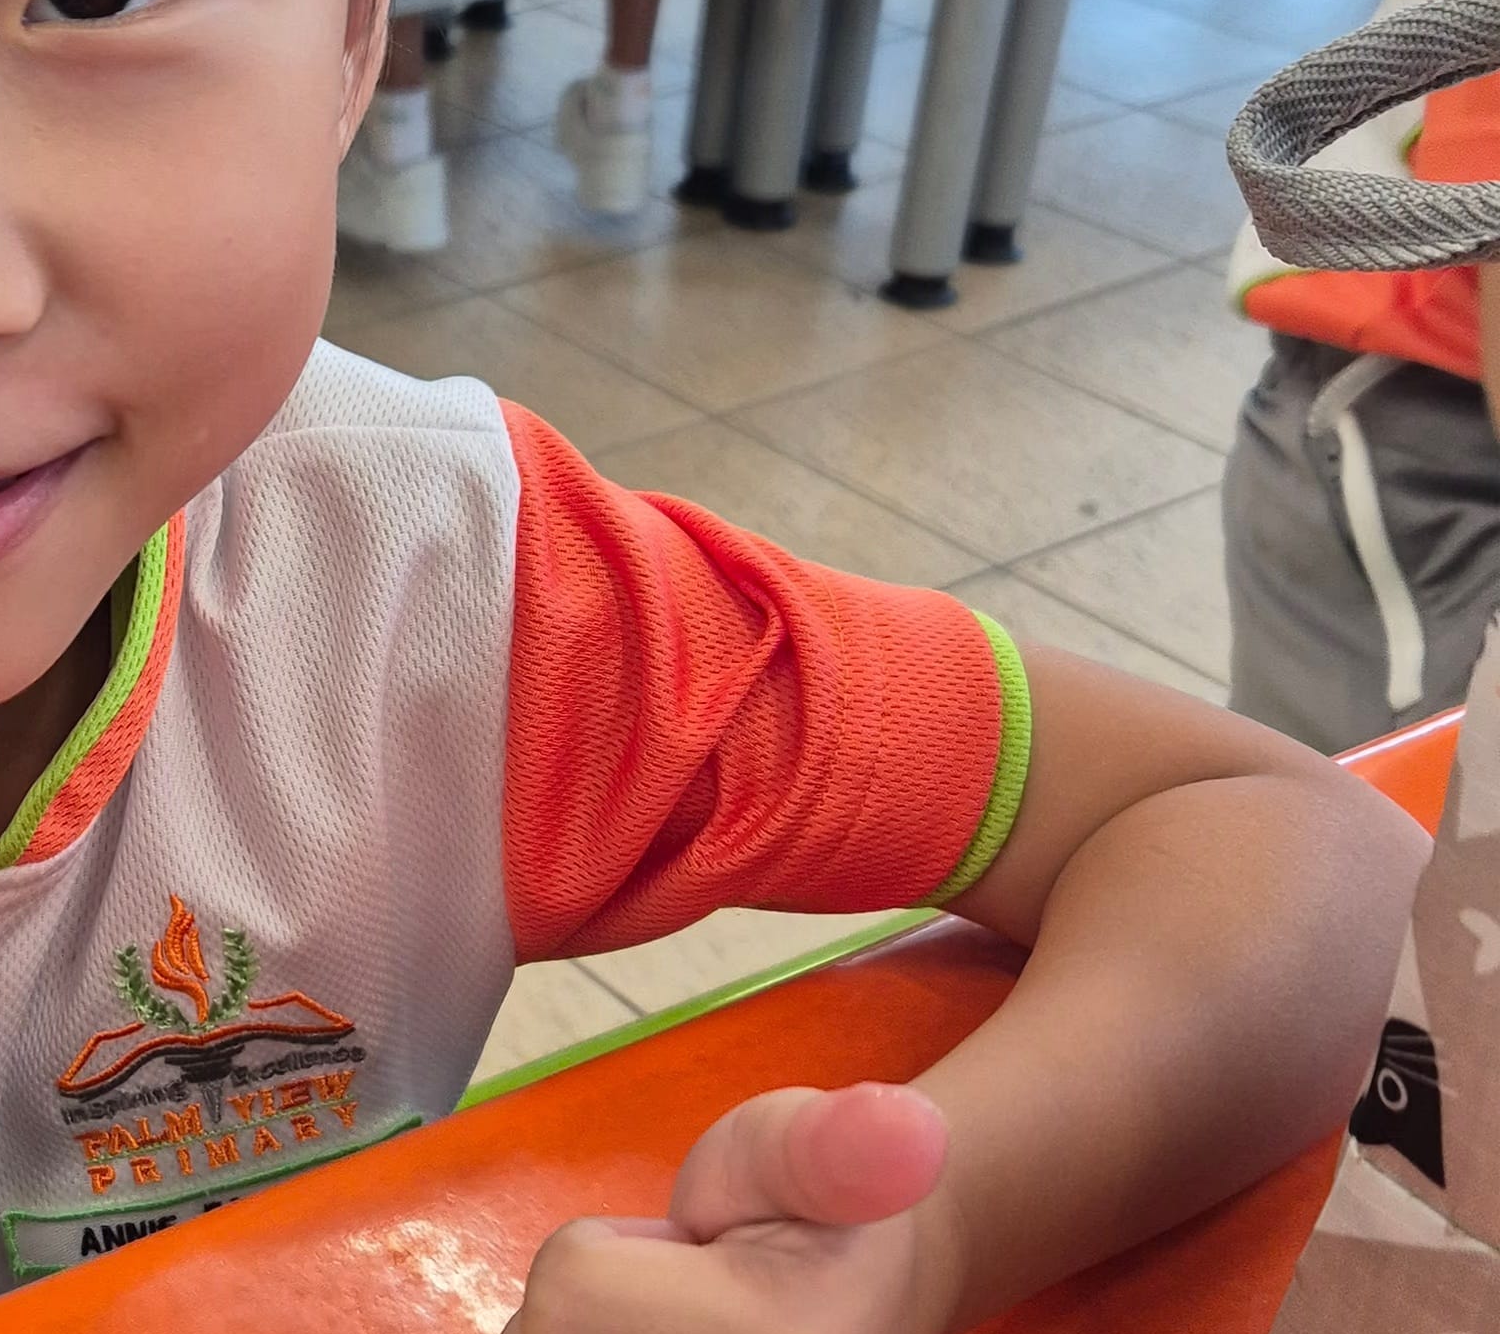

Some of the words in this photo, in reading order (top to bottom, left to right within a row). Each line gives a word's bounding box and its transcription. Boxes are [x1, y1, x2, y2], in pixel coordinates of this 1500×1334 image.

[75, 1103, 203, 1159] PALM
[226, 1069, 356, 1124] VIEW
[87, 1102, 357, 1195] PRIMARY
